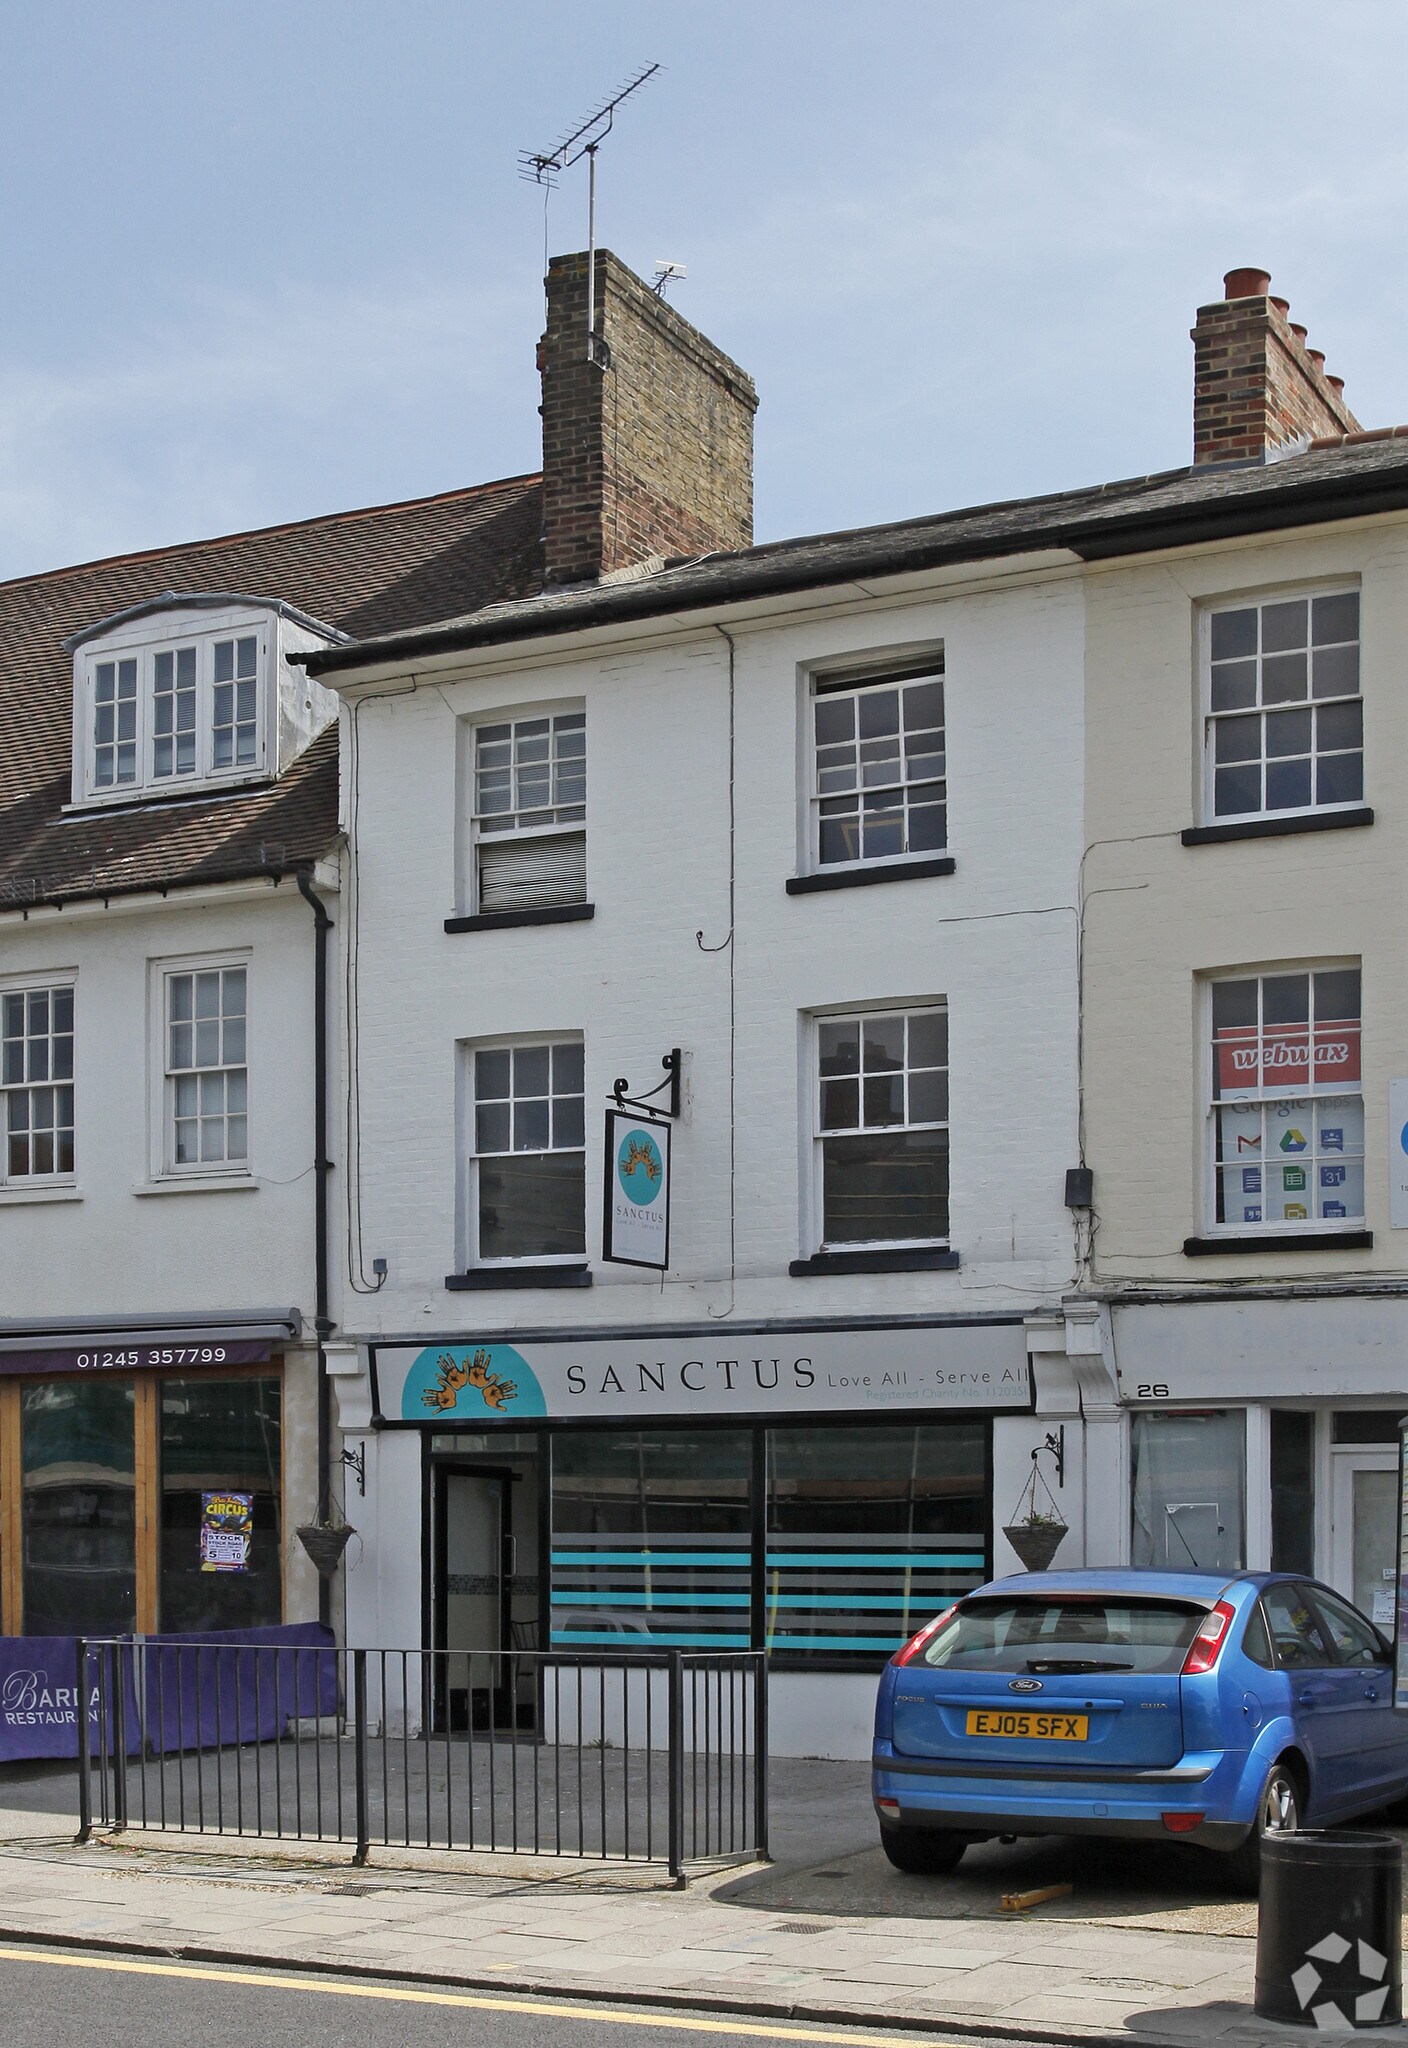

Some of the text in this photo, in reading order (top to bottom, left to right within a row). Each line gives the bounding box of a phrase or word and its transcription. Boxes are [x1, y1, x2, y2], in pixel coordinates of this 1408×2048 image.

[1232, 1042, 1349, 1070] webwax
[1325, 1172, 1341, 1184] 31
[616, 1205, 664, 1223] SANCTUS
[77, 1348, 226, 1368] 01245 357799
[566, 1358, 815, 1394] SANCTUS
[827, 1373, 872, 1387] Love
[882, 1371, 907, 1386] All
[935, 1369, 991, 1384] Serve
[1001, 1367, 1028, 1382] All
[866, 1389, 919, 1401] Registered
[922, 1388, 959, 1400] Charity
[1137, 1384, 1170, 1398] 26
[206, 1504, 248, 1515] CIRCUS
[2, 1669, 100, 1711] BARA
[975, 1715, 1078, 1737] EJ05 SFX
